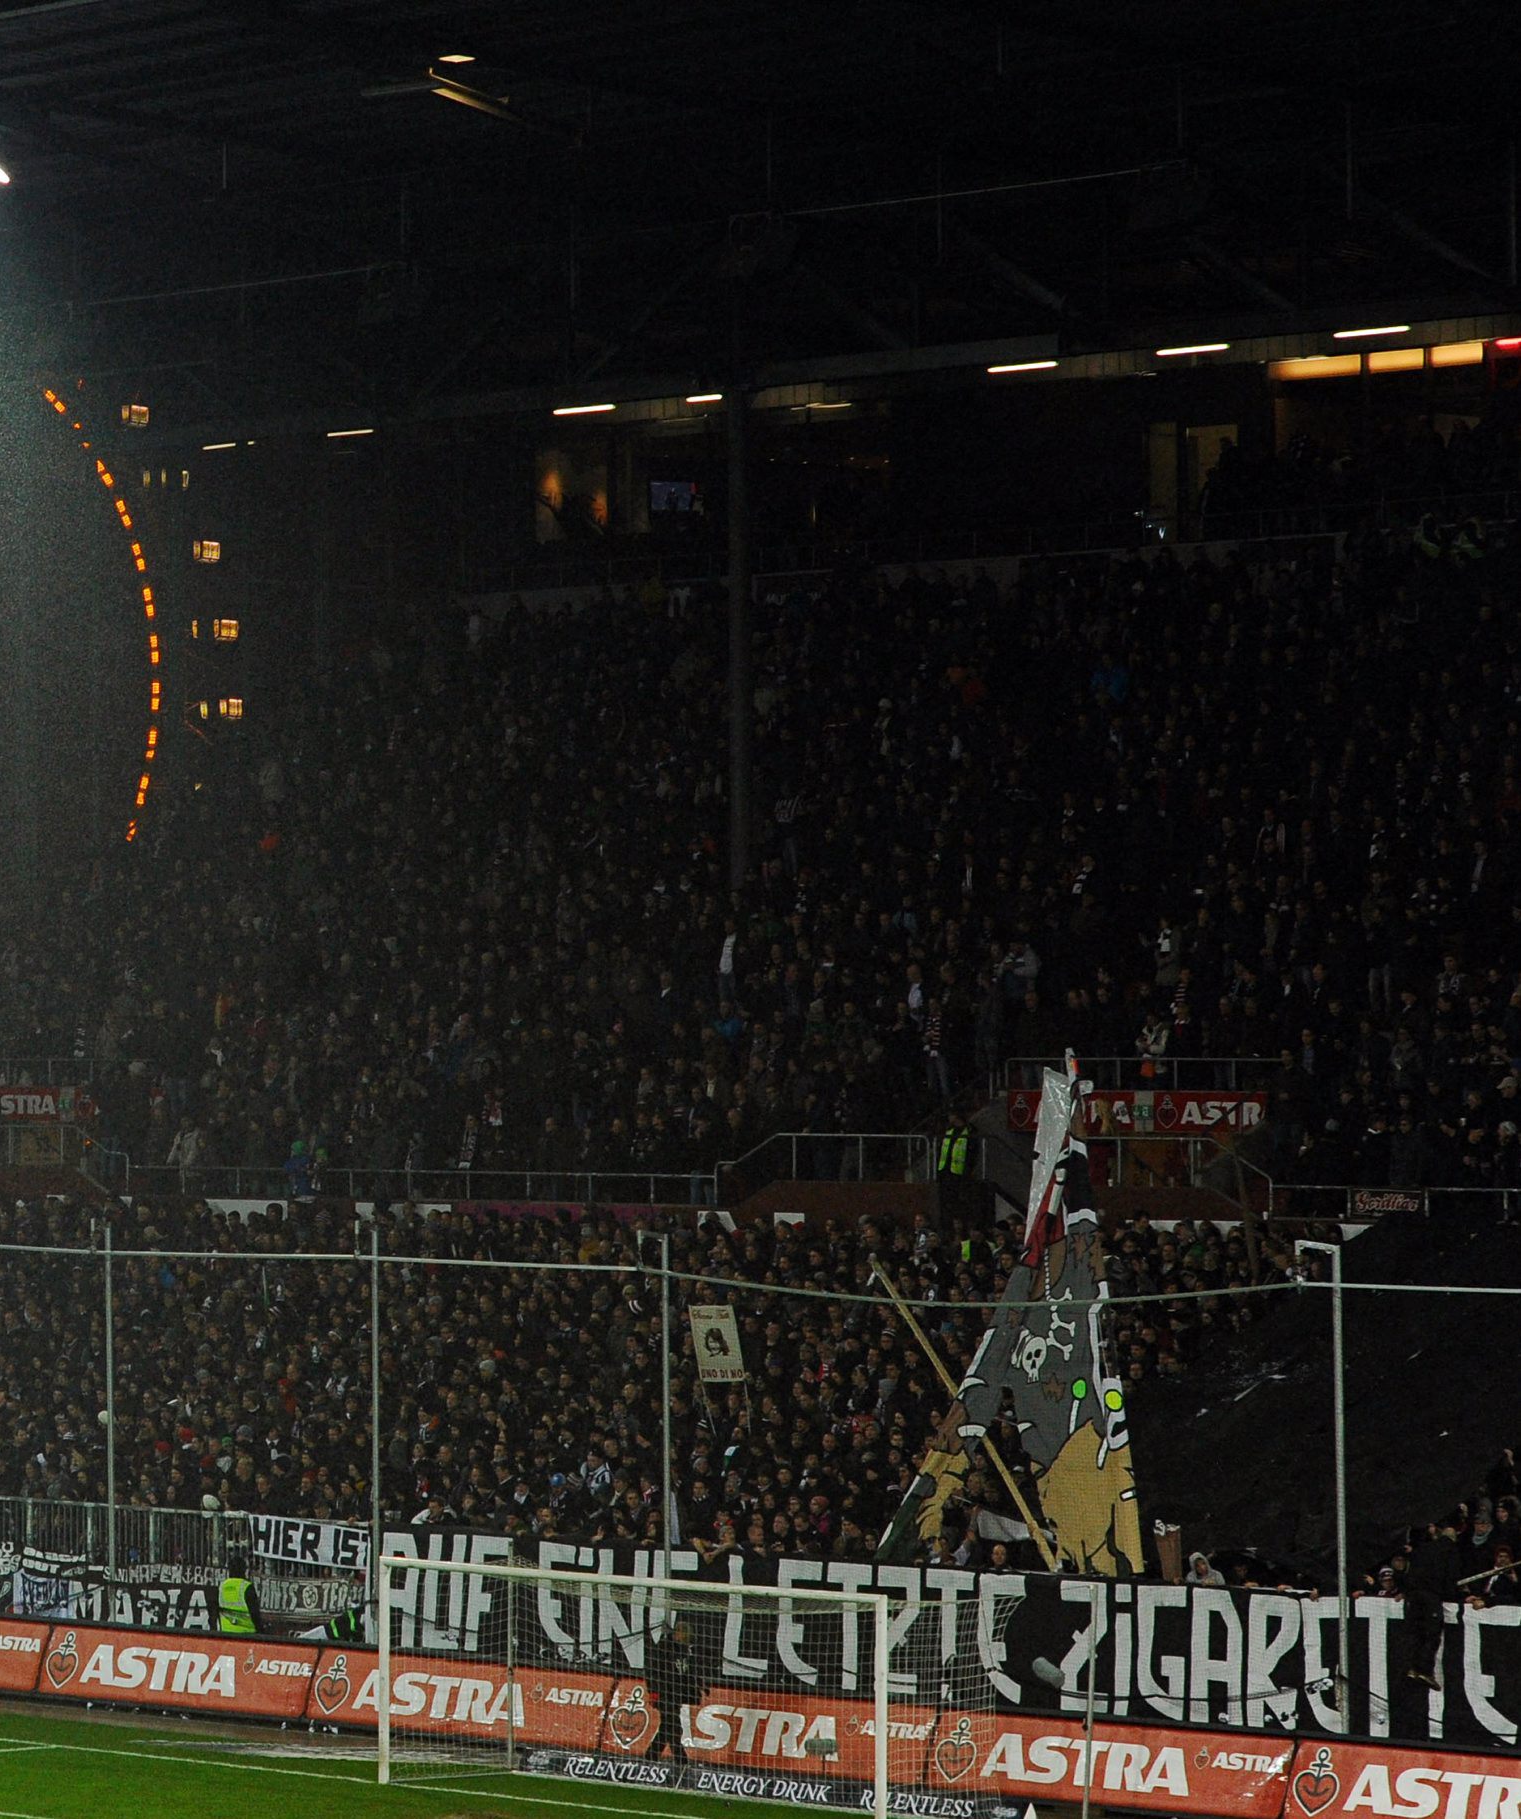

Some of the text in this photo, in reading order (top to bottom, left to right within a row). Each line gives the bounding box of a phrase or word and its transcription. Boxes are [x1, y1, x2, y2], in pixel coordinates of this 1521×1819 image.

[0, 1095, 56, 1115] STRA
[1180, 1101, 1268, 1126] ASTR
[252, 1515, 321, 1563] HIER
[67, 1579, 211, 1632] MAFIA
[382, 1532, 512, 1652] AUF
[722, 1554, 1026, 1706] LETZTE
[80, 1643, 236, 1698] ASTRA
[255, 1659, 313, 1678] ASTRA
[351, 1669, 526, 1728] ASTRA
[544, 1687, 605, 1707] ASTRA
[860, 1719, 927, 1742] ATRA
[564, 1757, 669, 1784] RELENTLESS
[979, 1732, 1189, 1797] ASTRA
[1211, 1751, 1286, 1774] ASTRA
[697, 1772, 832, 1803] ENERGY DRINK
[1342, 1763, 1521, 1819] ASTR
